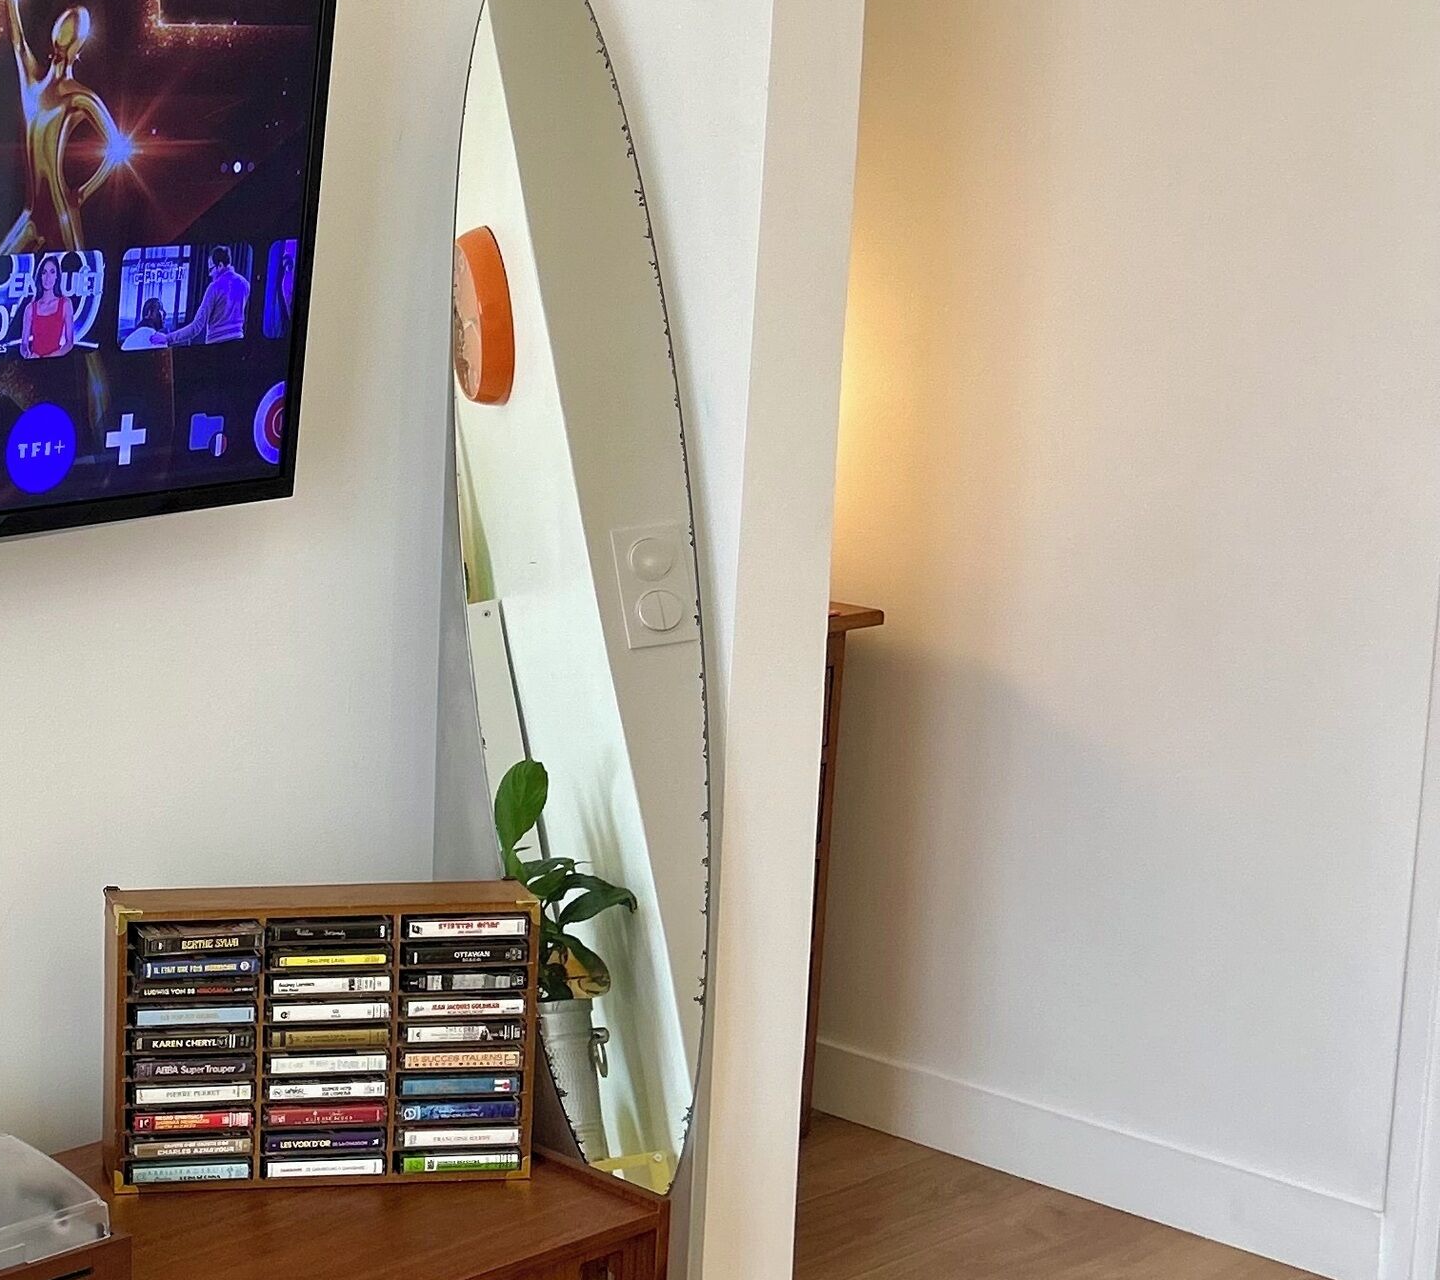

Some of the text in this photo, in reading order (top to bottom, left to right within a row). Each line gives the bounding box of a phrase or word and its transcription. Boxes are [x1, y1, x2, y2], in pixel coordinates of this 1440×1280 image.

[152, 1038, 217, 1048] KAREN CHERYL
[180, 1065, 205, 1075] Super
[205, 1064, 236, 1074] Trouper
